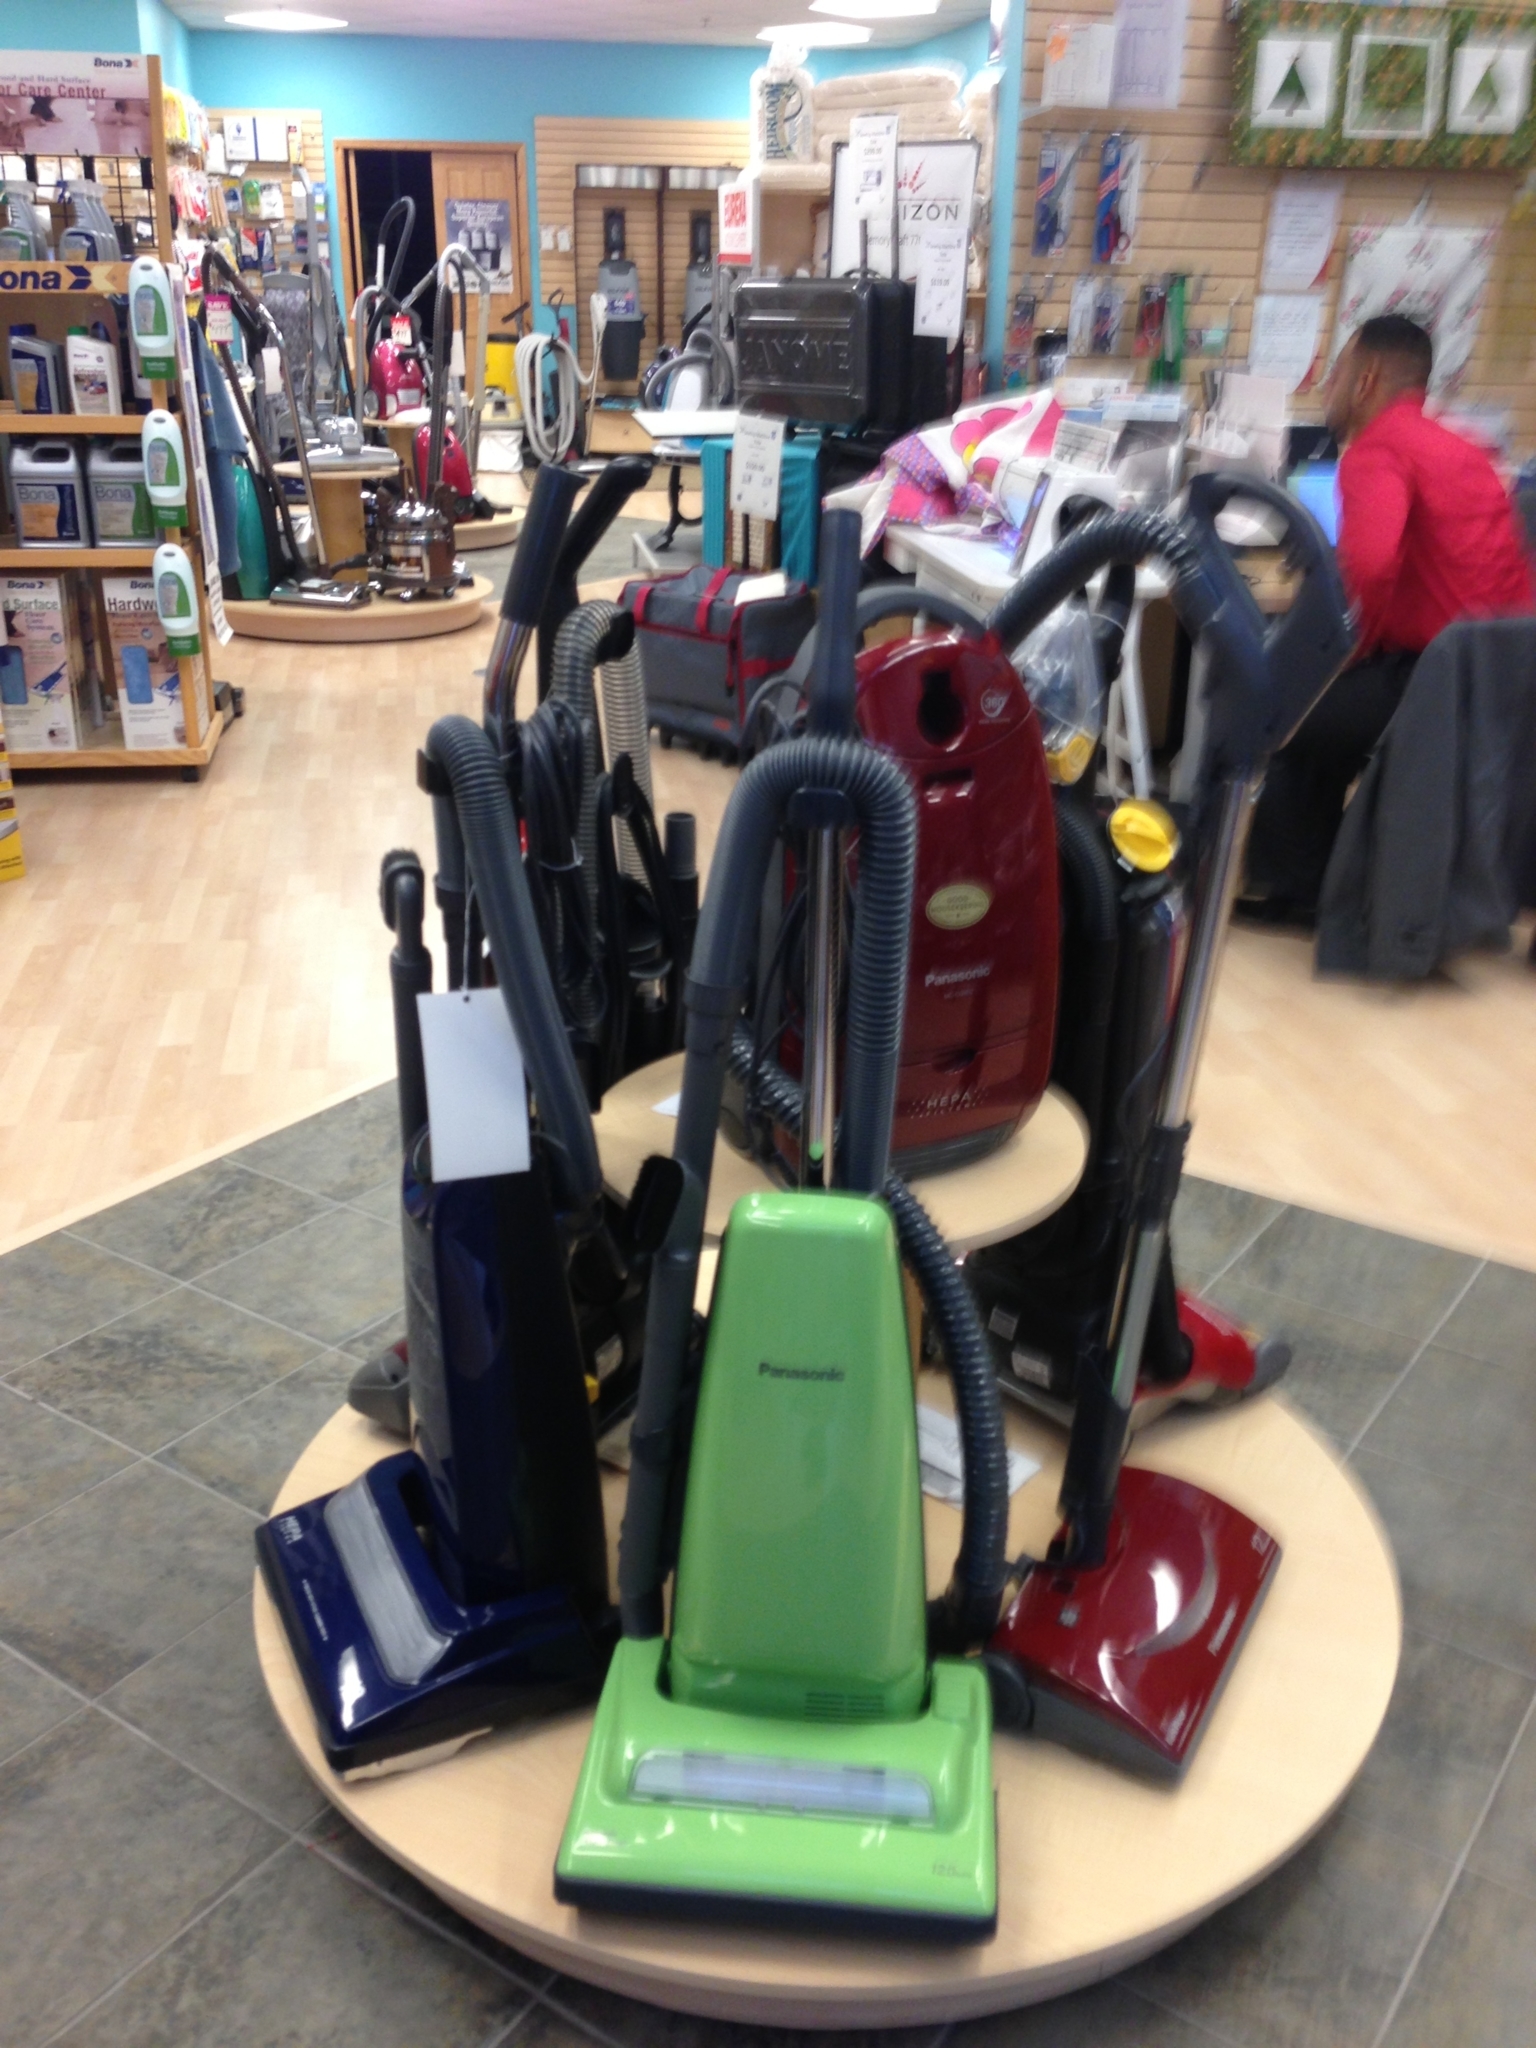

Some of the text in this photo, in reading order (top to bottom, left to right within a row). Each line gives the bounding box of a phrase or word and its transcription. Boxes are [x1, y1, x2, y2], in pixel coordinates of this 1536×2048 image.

[93, 57, 123, 69] Bona
[18, 83, 52, 98] Care
[58, 84, 106, 99] Center
[901, 203, 960, 222] IZON
[0, 269, 62, 291] ona
[17, 486, 56, 501] Bona
[94, 485, 132, 500] Bona
[7, 580, 36, 590] Bona
[14, 599, 60, 611] Surface
[107, 597, 157, 612] Hardw
[925, 966, 991, 987] Panasonic
[926, 1091, 972, 1110] HEPA
[758, 1362, 845, 1382] Panasonic
